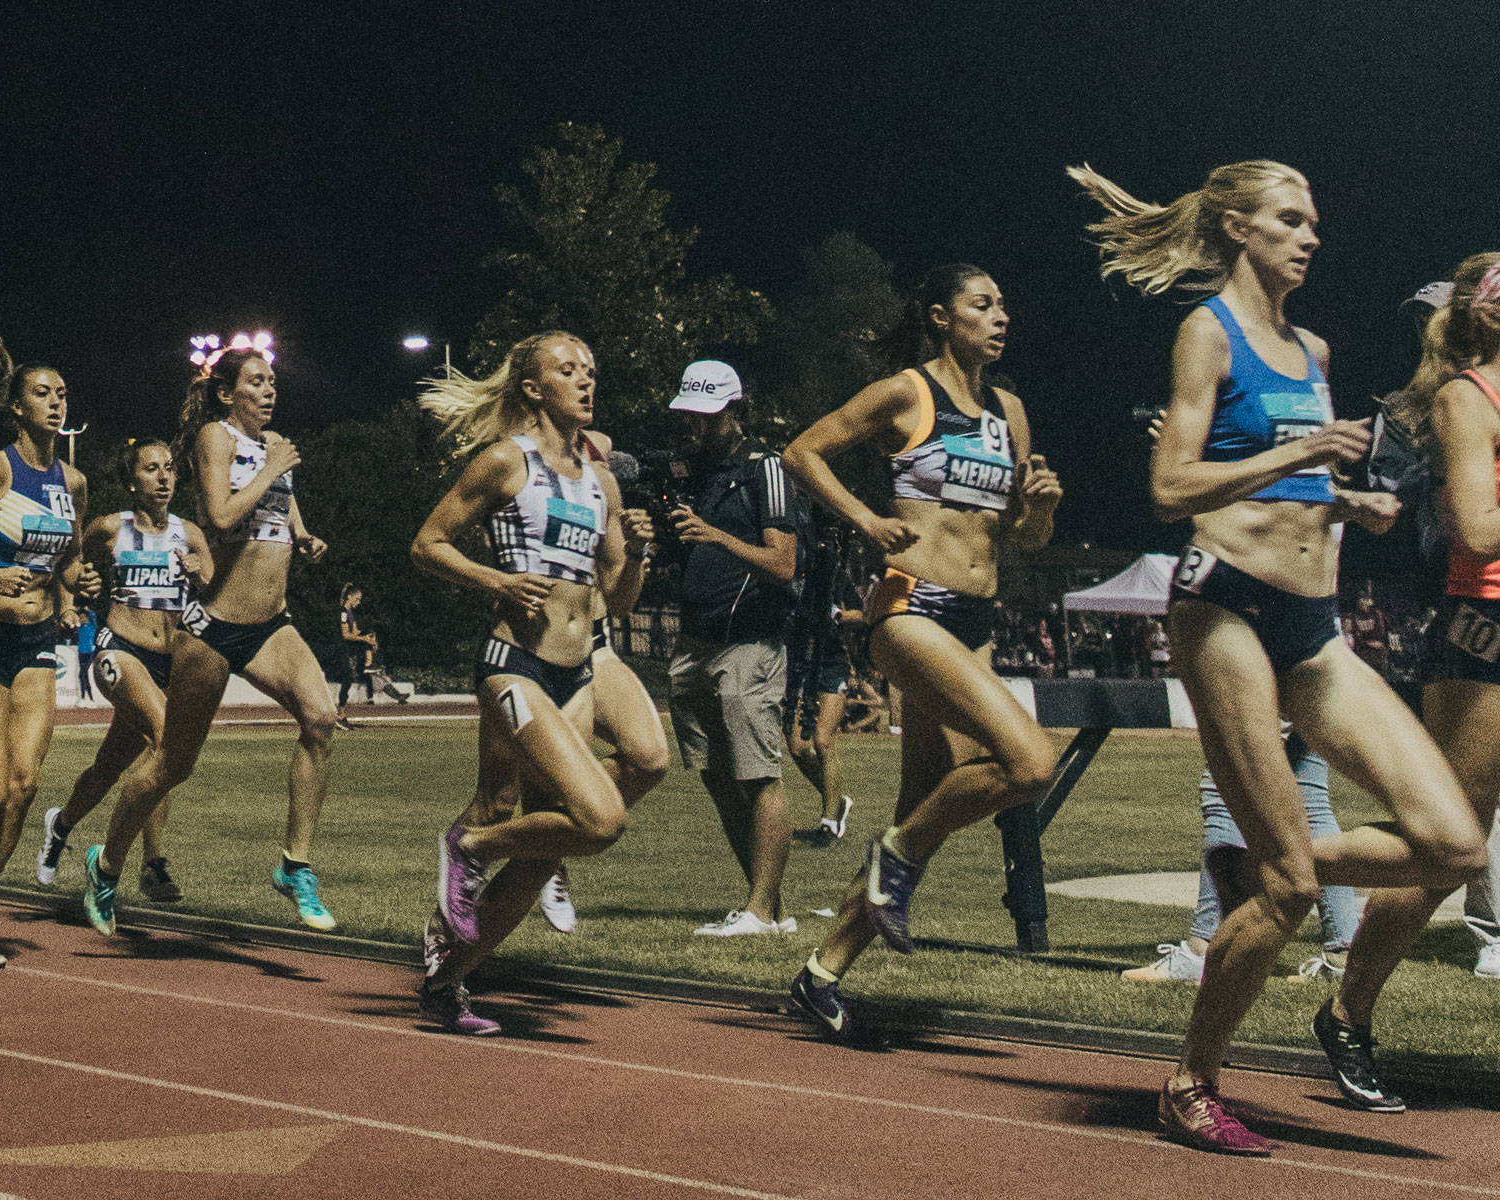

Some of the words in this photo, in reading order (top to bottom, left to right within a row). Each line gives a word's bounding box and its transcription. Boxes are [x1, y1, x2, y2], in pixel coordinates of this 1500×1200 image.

[681, 378, 716, 394] ciele
[987, 417, 1002, 452] 9
[100, 658, 117, 686] 3
[500, 689, 520, 729] 7
